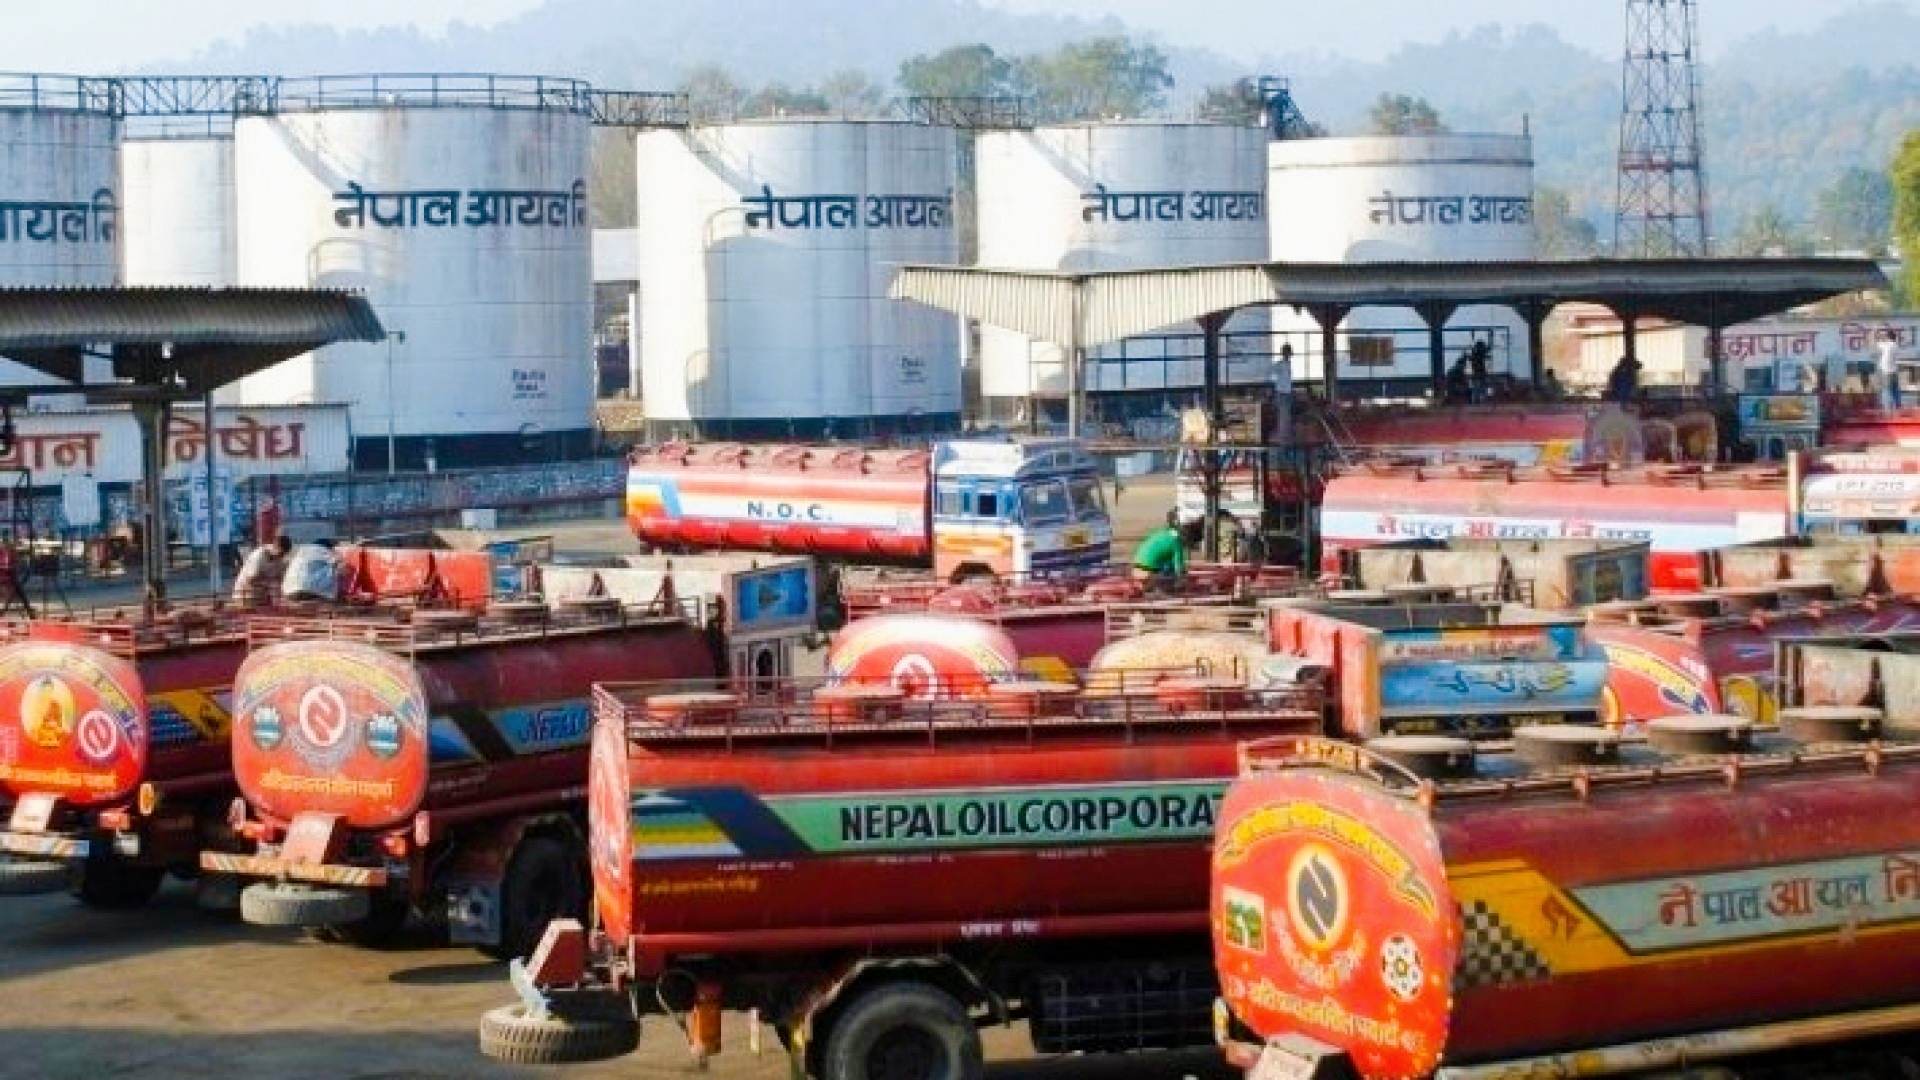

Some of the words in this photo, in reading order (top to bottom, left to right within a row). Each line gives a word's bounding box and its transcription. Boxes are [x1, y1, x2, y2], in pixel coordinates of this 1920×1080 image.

[332, 180, 460, 227] नेपाल
[741, 184, 857, 229] नेपाल
[1080, 183, 1183, 224] नेपाल
[1369, 190, 1462, 225] नेपाल
[1660, 882, 1762, 927] नेपाल
[1768, 865, 1869, 917] आयल
